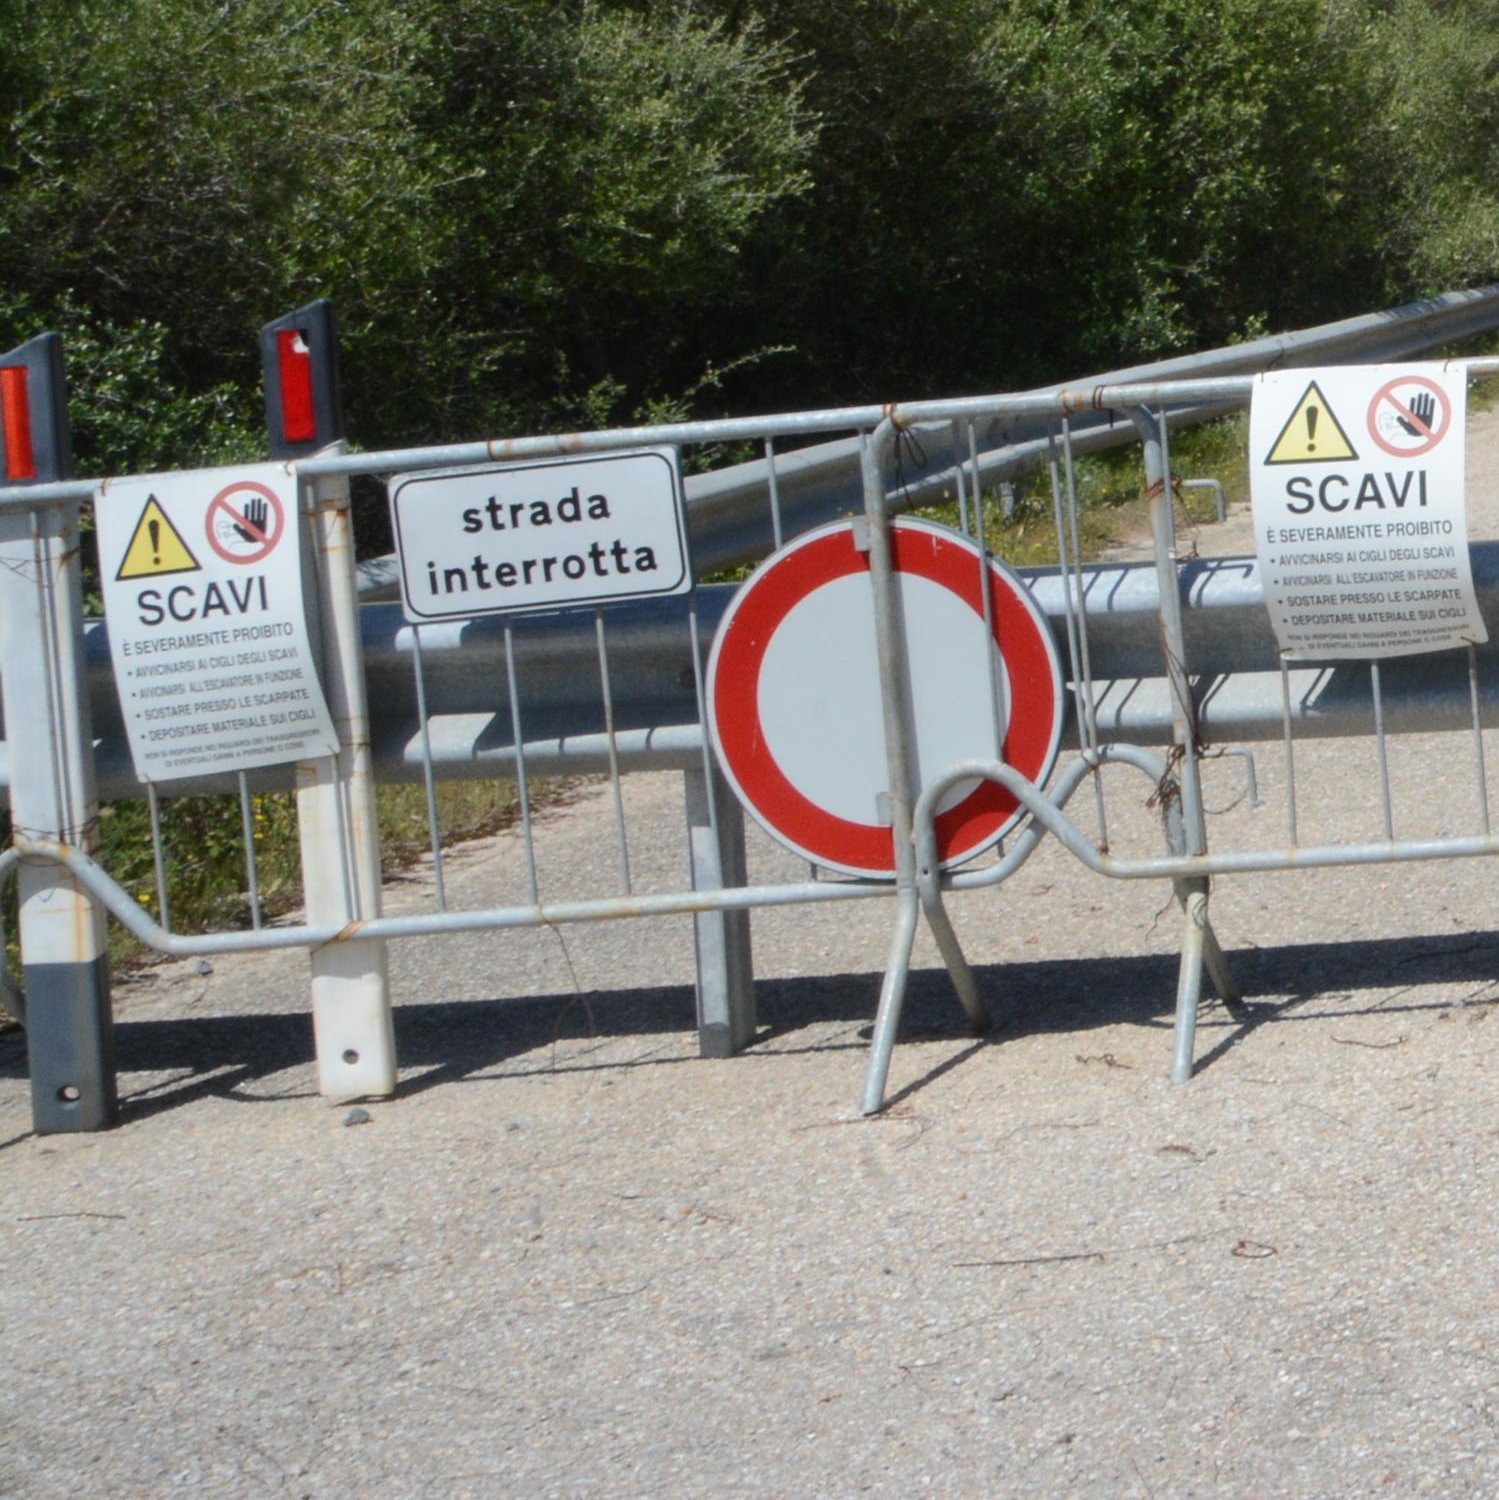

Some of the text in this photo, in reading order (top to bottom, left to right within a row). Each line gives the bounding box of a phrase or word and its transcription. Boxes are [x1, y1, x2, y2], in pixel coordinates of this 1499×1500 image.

[1286, 470, 1426, 514] SCAVI
[462, 486, 611, 534] strada
[1280, 523, 1382, 543] SEVERAMENTE
[1387, 520, 1453, 537] PROIBITO
[427, 539, 658, 595] interrotta
[1279, 546, 1455, 566] AVVICINARSI AI CIGLI DEGLI SCAVI
[1282, 574, 1332, 587] AVVICINARSI
[1408, 570, 1416, 581] IN
[1417, 568, 1458, 581] FUNZIONE
[138, 576, 268, 626] SCAVI
[1286, 588, 1462, 607] SOSTARE PRESSO LE SCARPATE
[1291, 608, 1466, 626] DEPOSITARE MATERIALE SUI CIGLI
[134, 628, 230, 655] SEVERAMENTE
[232, 622, 294, 643] PROIBITO
[136, 647, 298, 678] AVVICINARSI AI CIGLI DEGLI SCAVI
[255, 673, 263, 685] IN
[264, 668, 304, 684] FUNZIONE
[144, 688, 310, 721] SOSTARE PRESSO LE SCARPATE
[149, 708, 316, 741] DEPOSITARE MATERIALE SUI CIGLI
